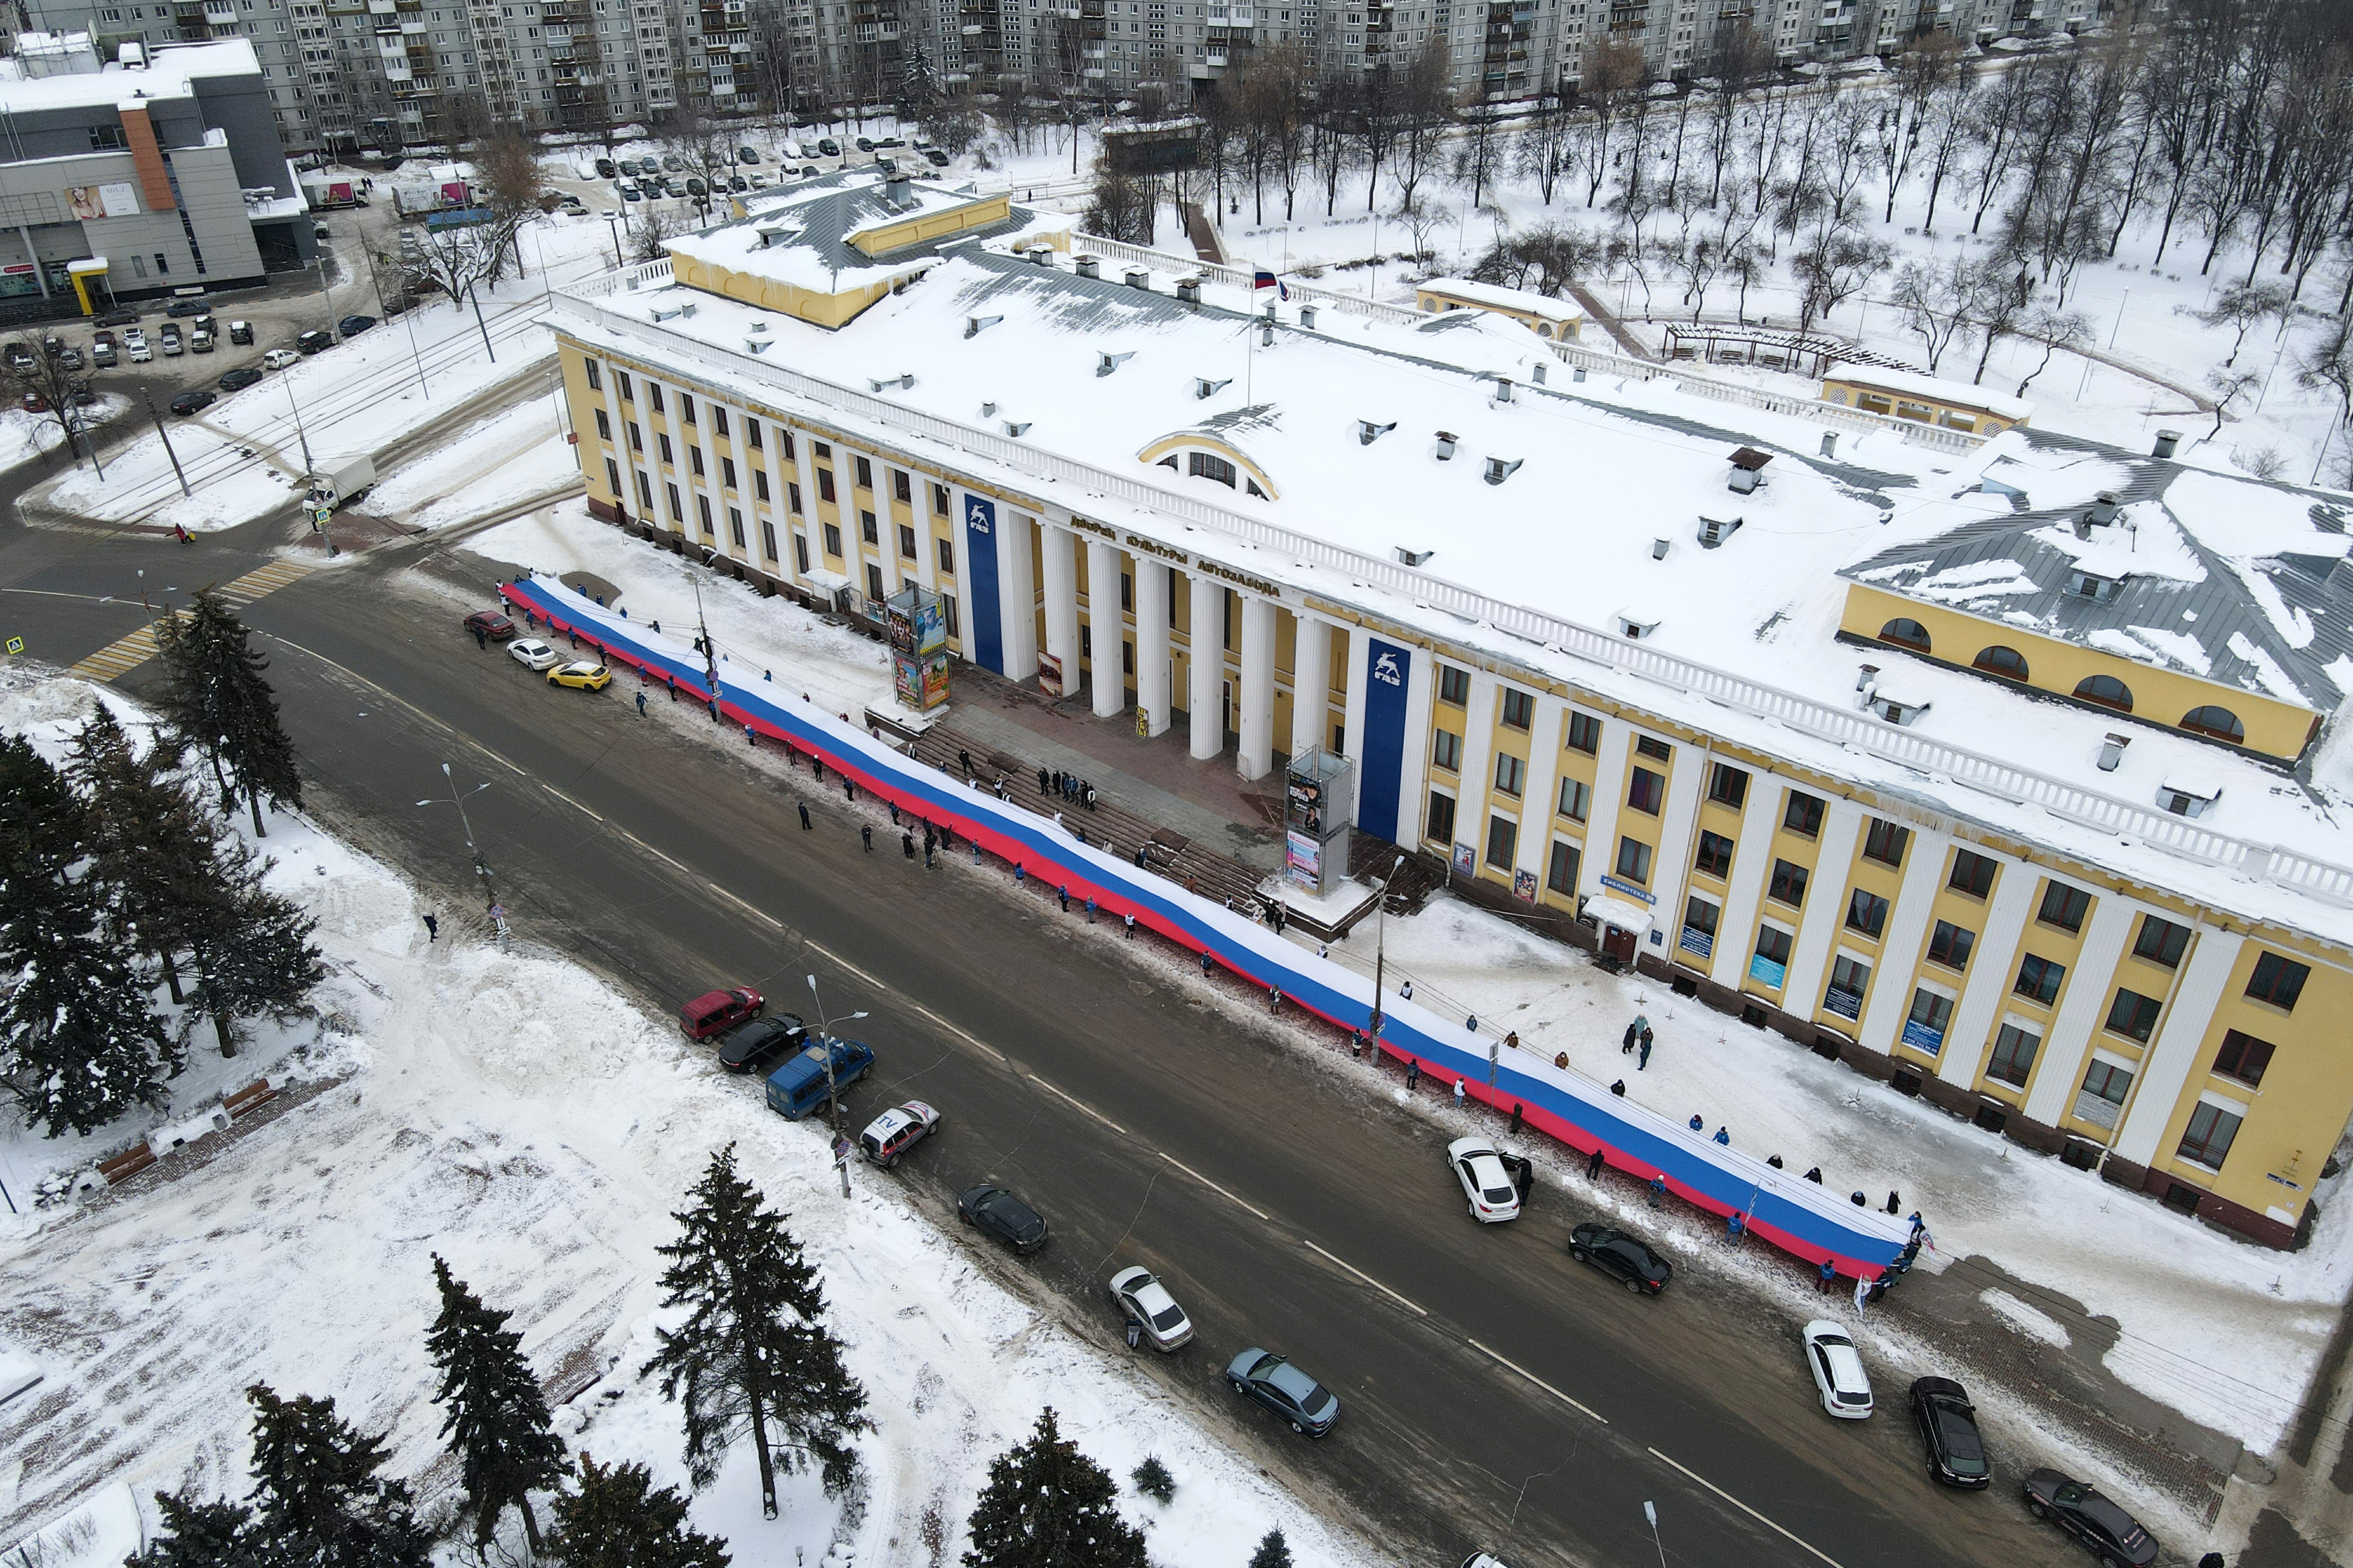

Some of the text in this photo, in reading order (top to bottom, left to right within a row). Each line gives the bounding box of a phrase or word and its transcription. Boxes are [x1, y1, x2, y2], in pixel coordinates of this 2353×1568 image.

[969, 521, 989, 534] ГАЗ
[1070, 515, 1280, 597] ДВОРЕЦ КУЛЬТУРЫ АВТОЗАВОДА
[1374, 671, 1401, 686] ГАЗ
[1604, 878, 1645, 899] БИБЛИОТЕКА
[878, 1116, 898, 1129] TV
